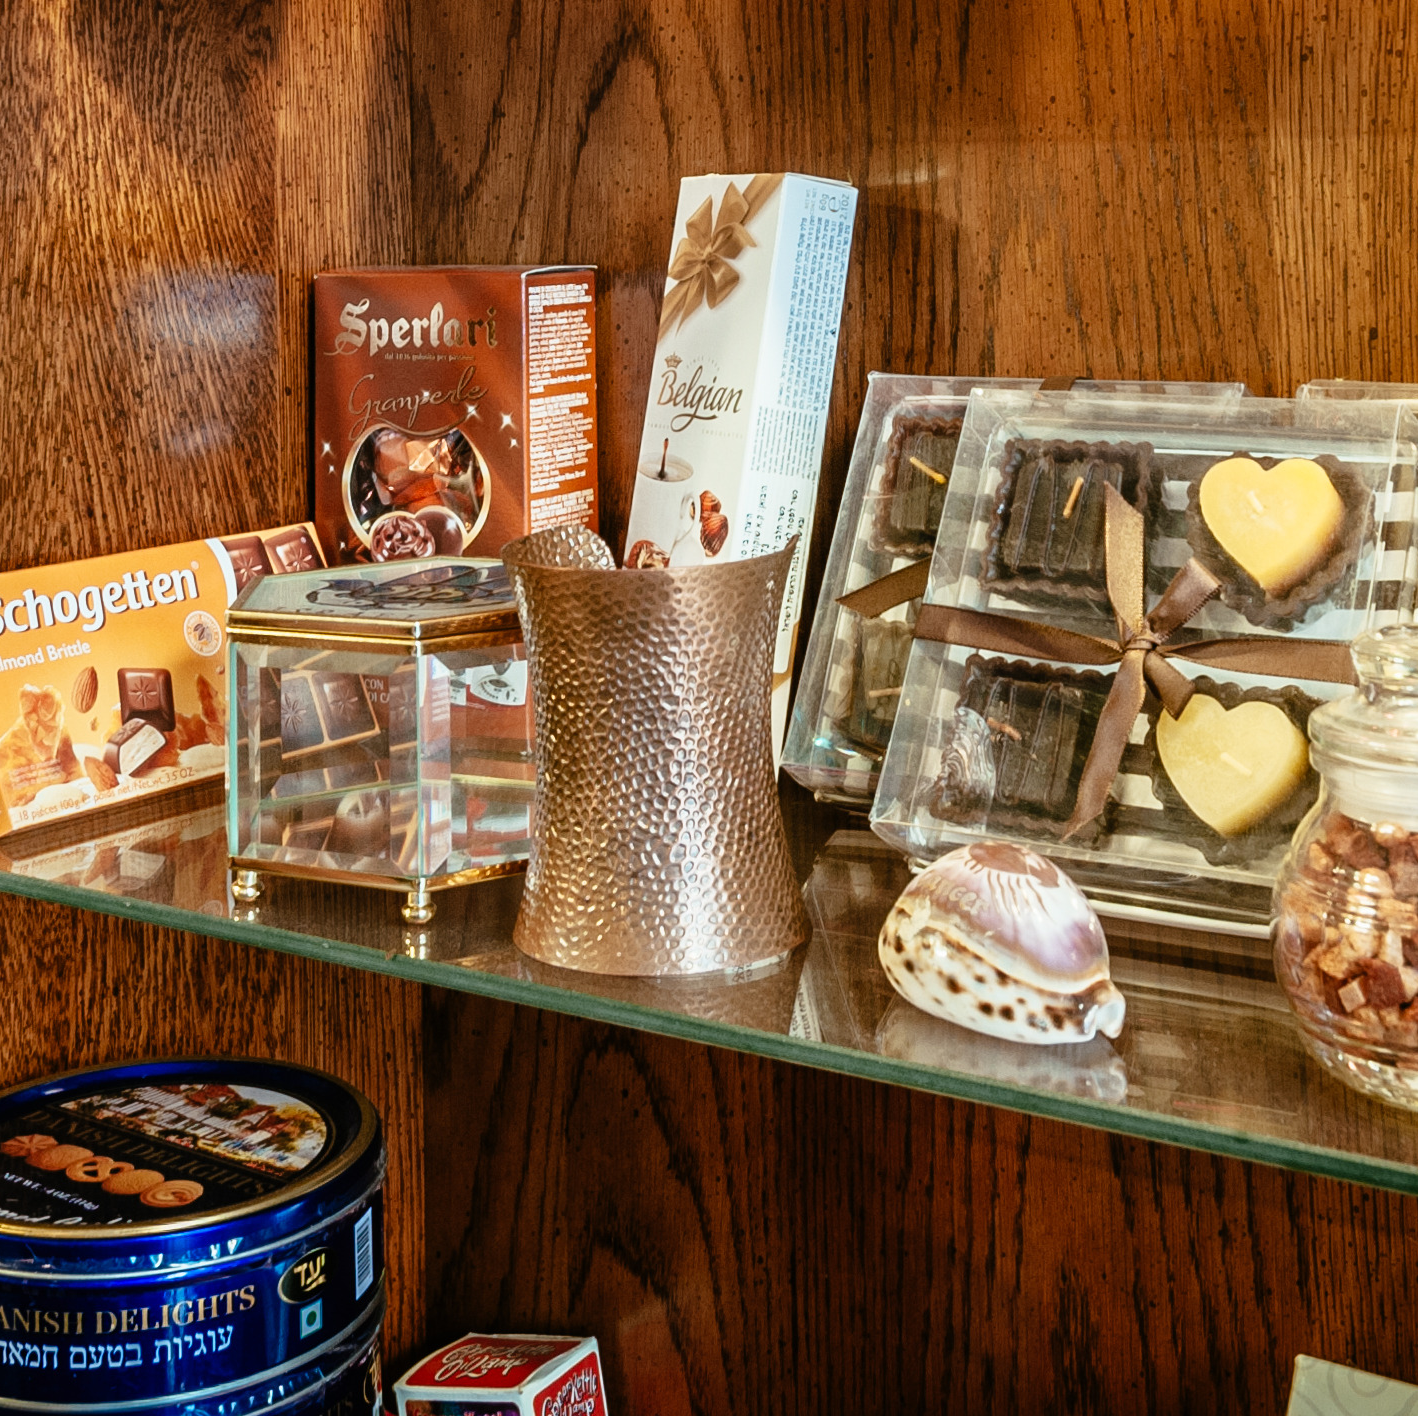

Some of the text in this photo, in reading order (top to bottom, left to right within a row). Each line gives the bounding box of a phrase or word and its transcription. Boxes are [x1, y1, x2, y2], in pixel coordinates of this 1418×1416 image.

[323, 298, 498, 357] Sperlari
[348, 365, 489, 441] Granperle
[657, 365, 743, 433] Belgian
[48, 640, 92, 662] Brittle
[19, 811, 29, 821] 18
[95, 1284, 257, 1335] DELIGHTS
[69, 1341, 143, 1370] בטעם
[153, 1325, 234, 1365] עוגיות
